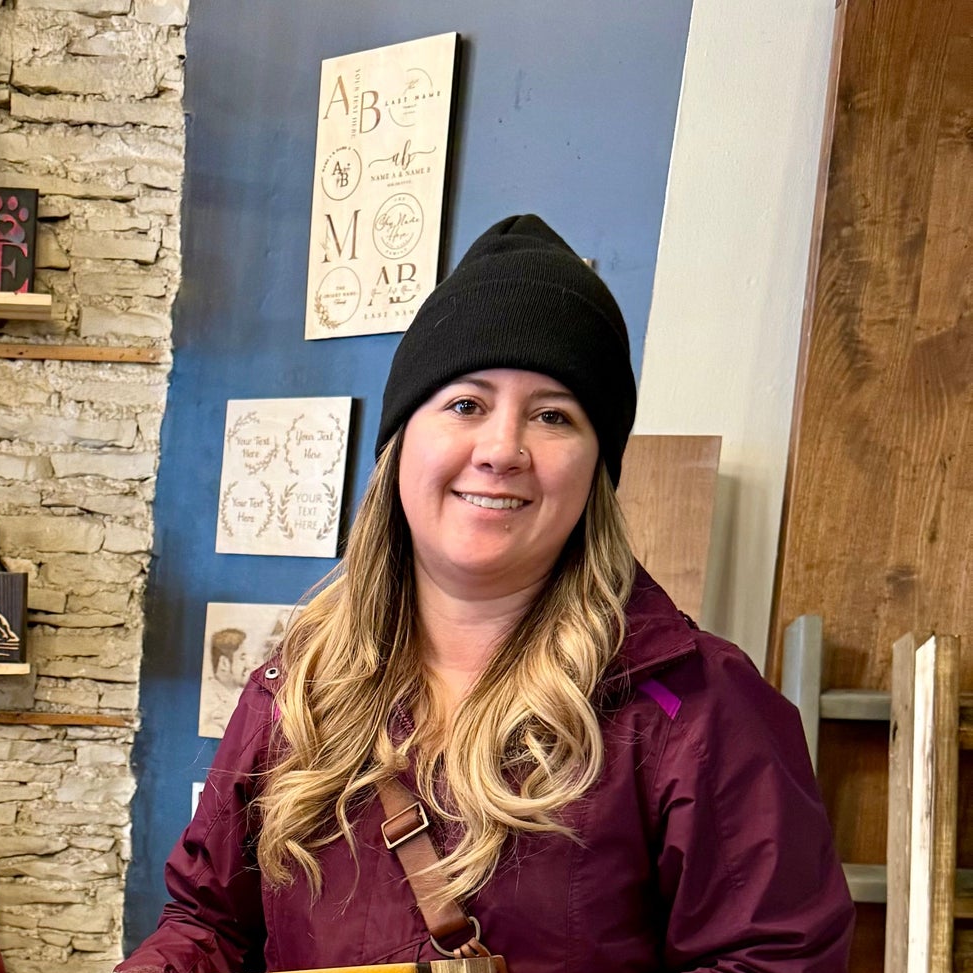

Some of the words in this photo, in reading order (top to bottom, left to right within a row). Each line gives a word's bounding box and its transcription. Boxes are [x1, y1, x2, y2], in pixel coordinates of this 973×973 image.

[323, 75, 349, 120] A
[359, 90, 381, 134] B
[321, 209, 361, 264] M
[296, 493, 323, 504] YOUR
[298, 506, 318, 517] TEXT
[294, 520, 318, 531] HERE
